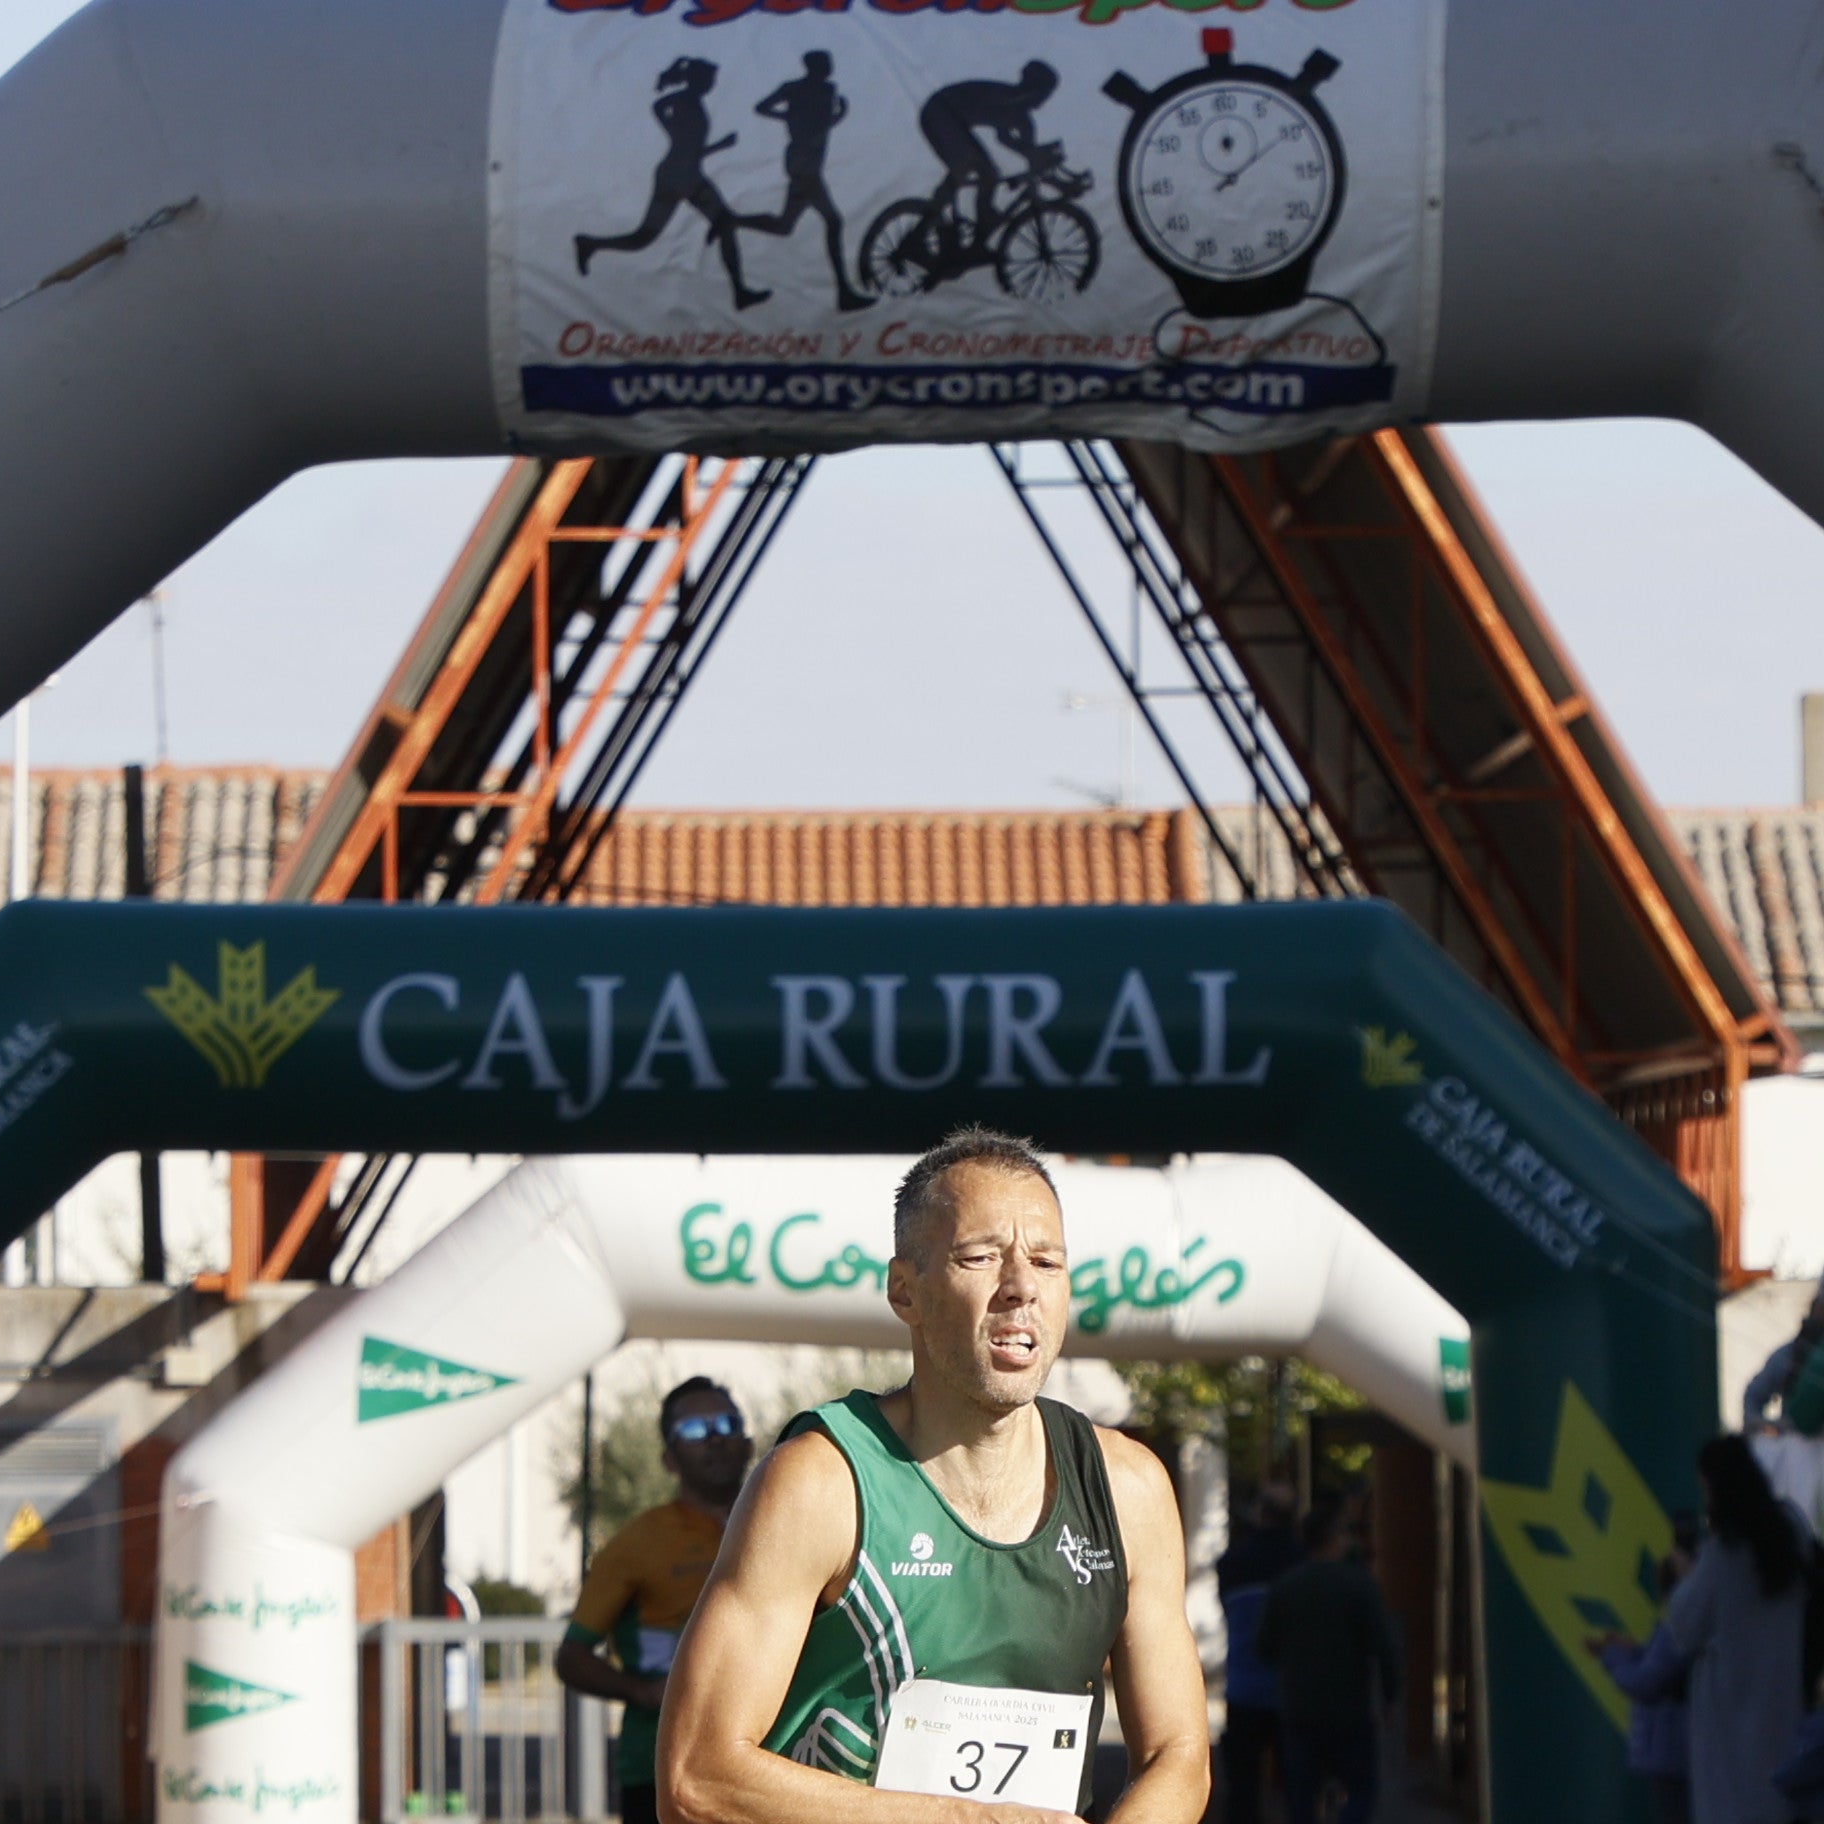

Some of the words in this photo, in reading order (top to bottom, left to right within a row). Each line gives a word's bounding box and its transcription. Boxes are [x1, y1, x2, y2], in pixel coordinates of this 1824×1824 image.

[358, 970, 729, 1121] CAJA
[769, 968, 1274, 1091] RURAL
[679, 1202, 757, 1284] El
[768, 1212, 890, 1292] Cor
[1070, 1234, 1246, 1336] glés
[891, 1562, 953, 1577] VIATOR
[948, 1740, 1030, 1796] 37
